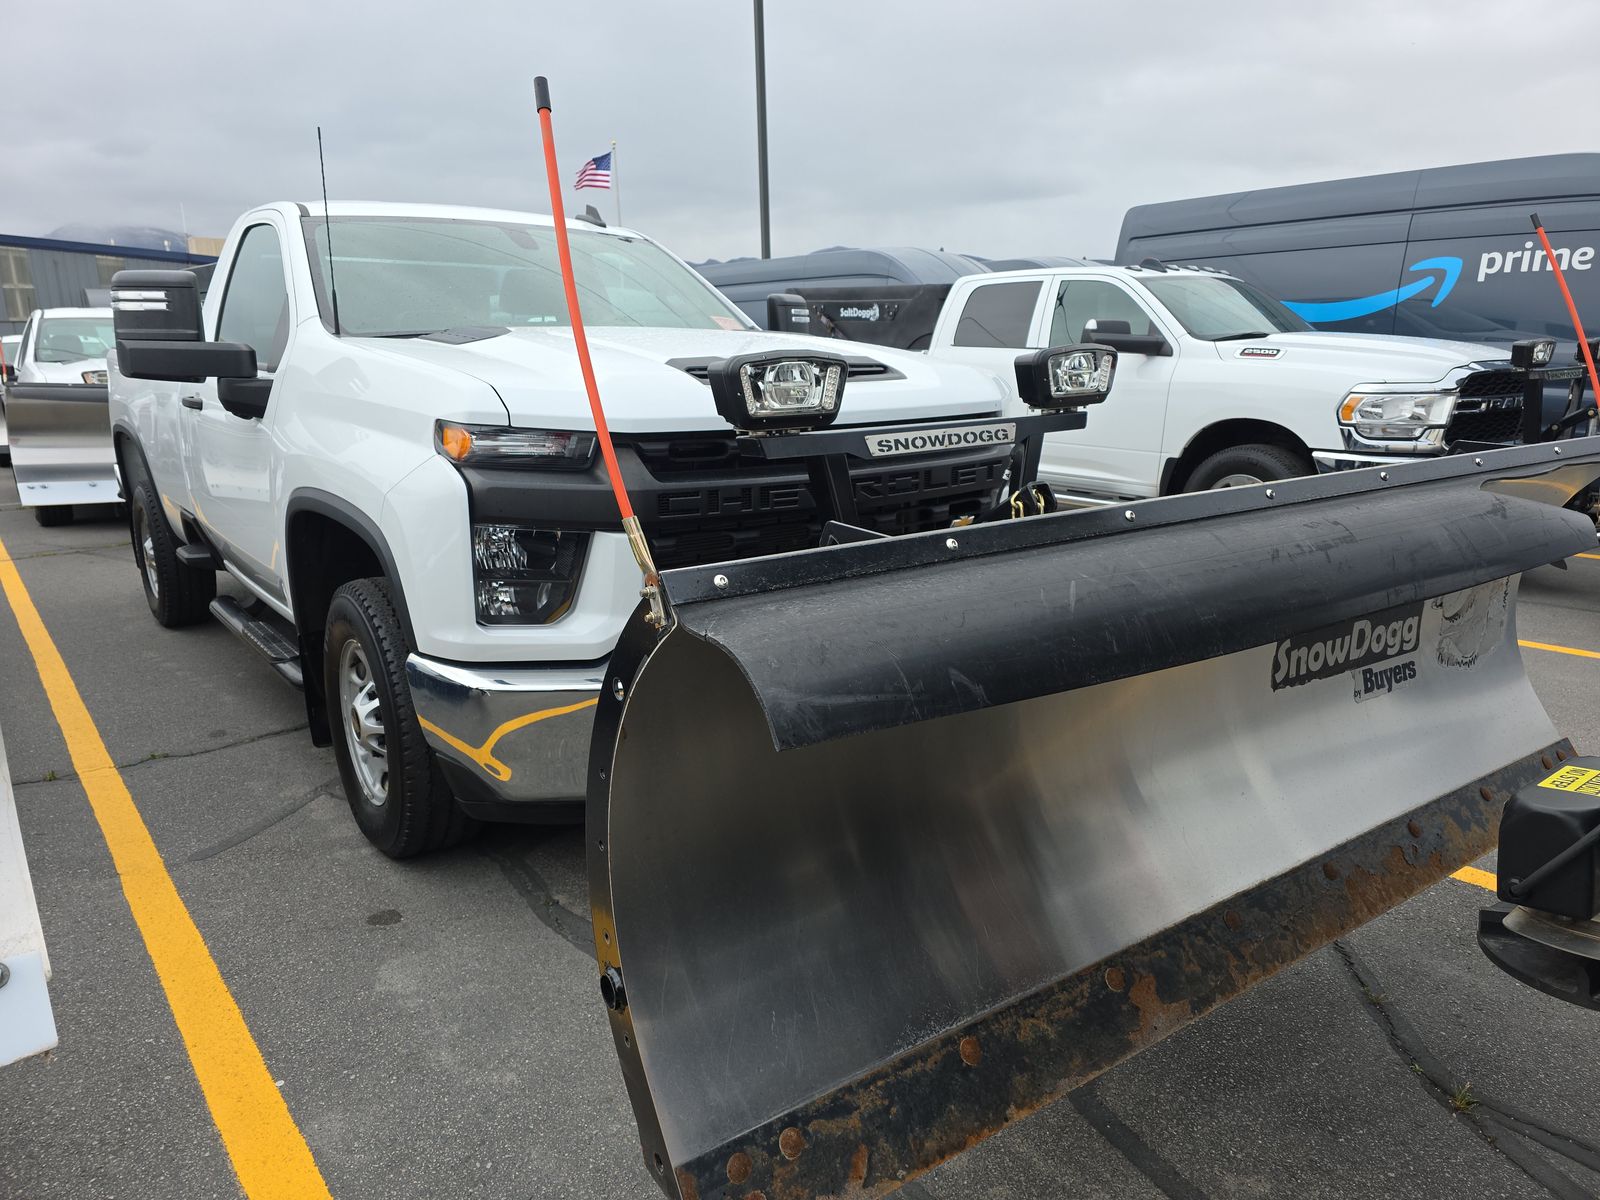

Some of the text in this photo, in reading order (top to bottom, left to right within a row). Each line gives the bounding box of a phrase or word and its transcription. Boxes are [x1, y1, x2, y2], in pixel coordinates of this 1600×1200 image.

[1477, 241, 1595, 282] prime
[840, 307, 871, 319] SaltDogg
[877, 428, 1009, 453] SNOWDOGG
[658, 461, 1003, 518] CHEROLET
[1274, 615, 1420, 684] SnowDogg
[1361, 660, 1417, 695] Buyers
[1549, 774, 1579, 788] STEP
